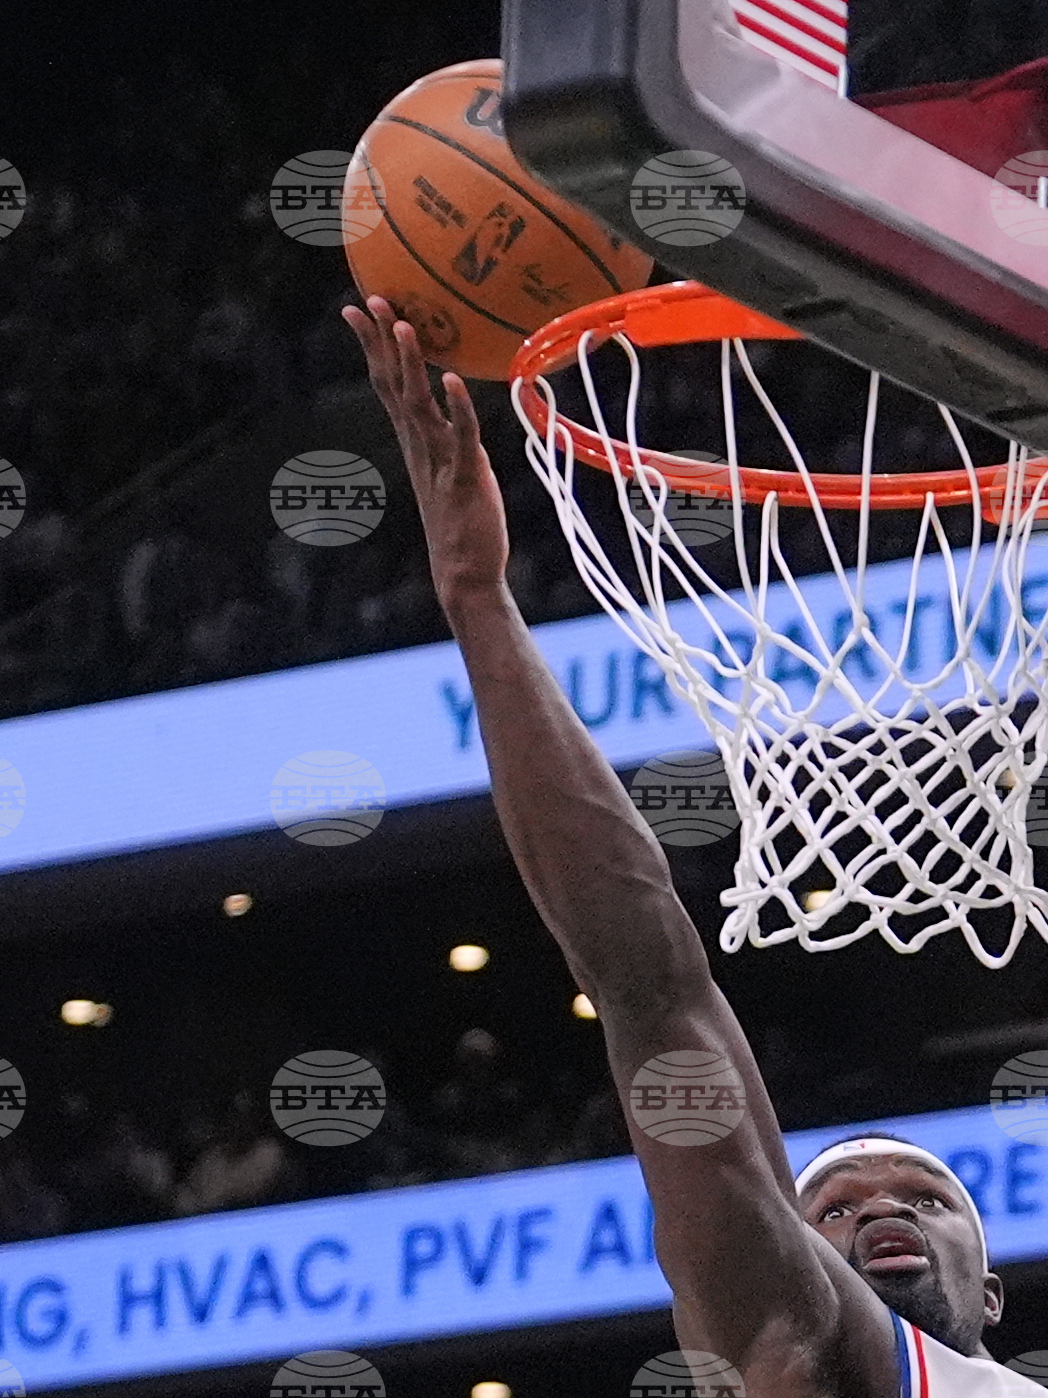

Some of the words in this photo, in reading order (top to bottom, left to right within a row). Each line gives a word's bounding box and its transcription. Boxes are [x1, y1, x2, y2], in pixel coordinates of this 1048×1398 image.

[440, 648, 675, 749] YUR
[116, 1233, 374, 1337] HVAC,
[401, 1206, 553, 1298] PVF
